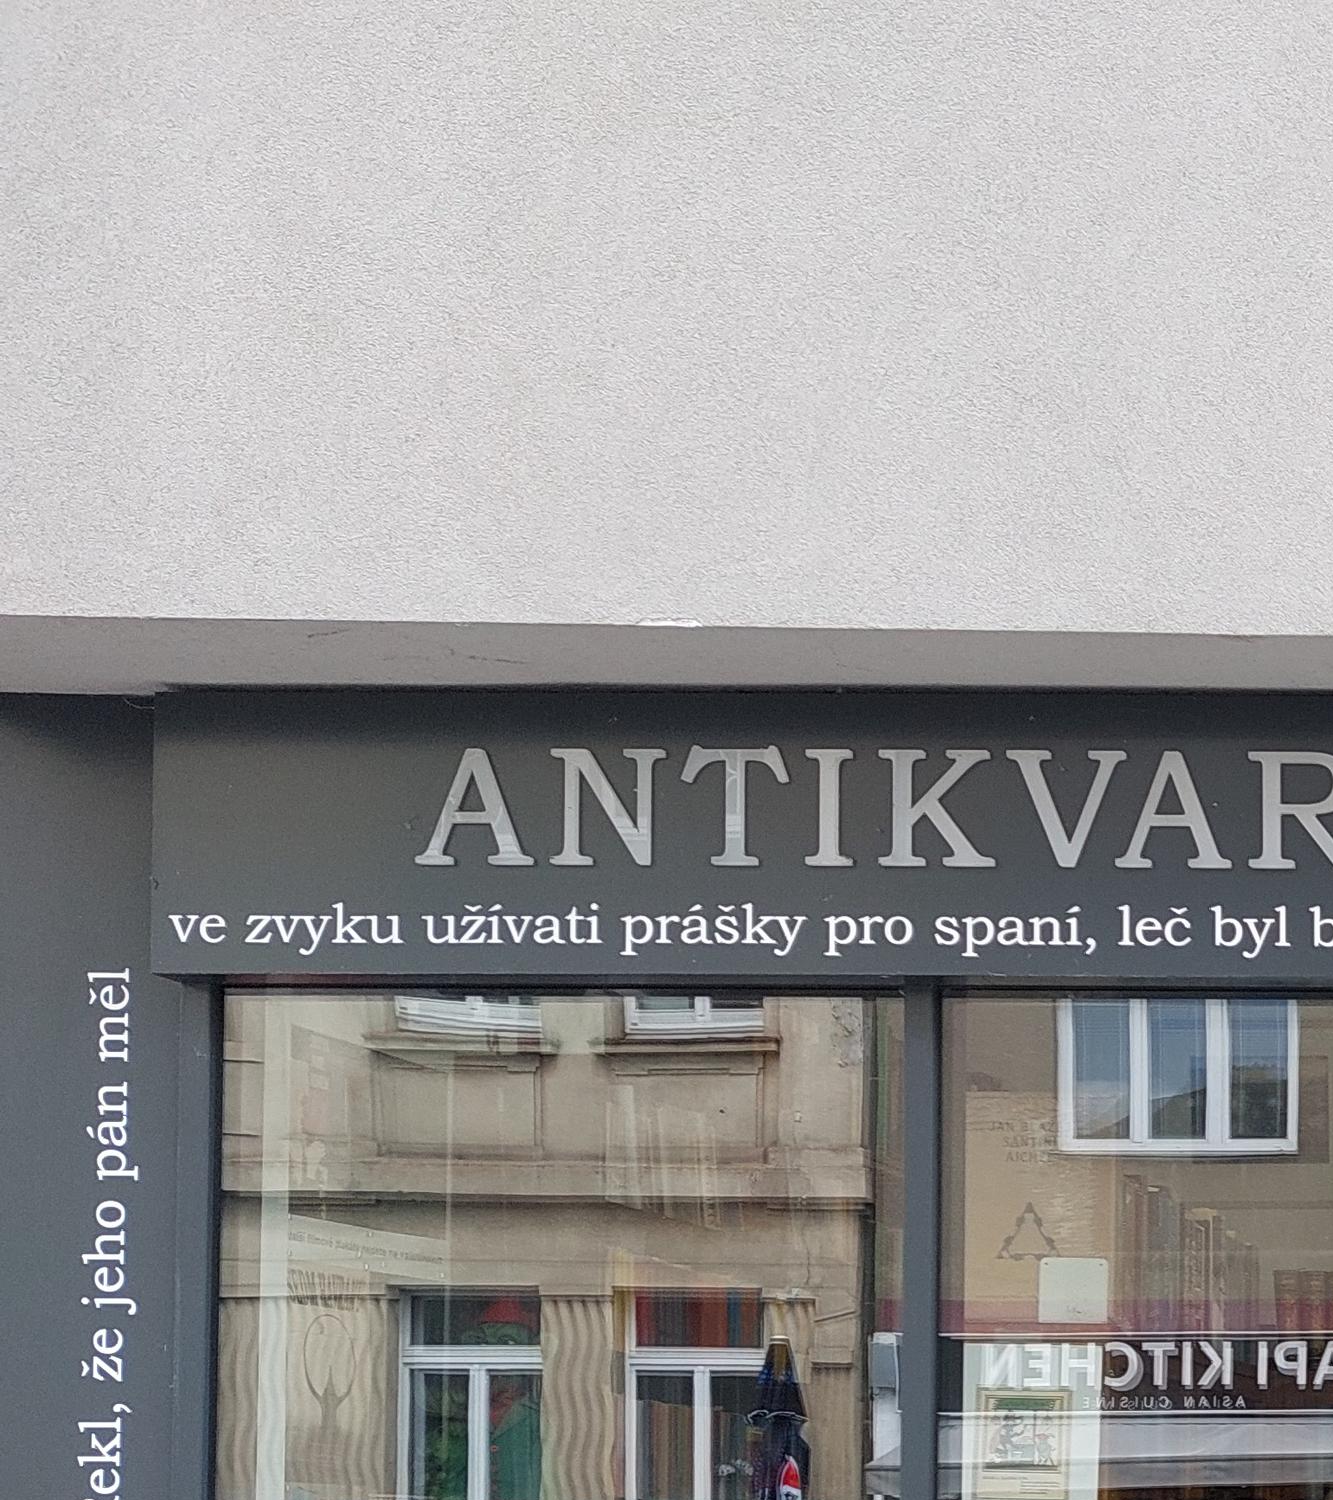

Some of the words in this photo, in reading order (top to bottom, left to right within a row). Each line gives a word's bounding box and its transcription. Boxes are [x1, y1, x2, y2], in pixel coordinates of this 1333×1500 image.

[168, 910, 227, 945] ve
[245, 904, 403, 955] zvyku
[423, 902, 600, 945] užívati
[620, 902, 805, 957] prášky
[824, 912, 912, 955] pro
[934, 905, 1097, 957] spaní,
[1119, 905, 1191, 947] leč
[1212, 907, 1291, 958] byl
[85, 964, 132, 1062] měl
[86, 1081, 140, 1182] pán
[81, 1198, 136, 1315] jeho
[81, 1325, 126, 1384] že
